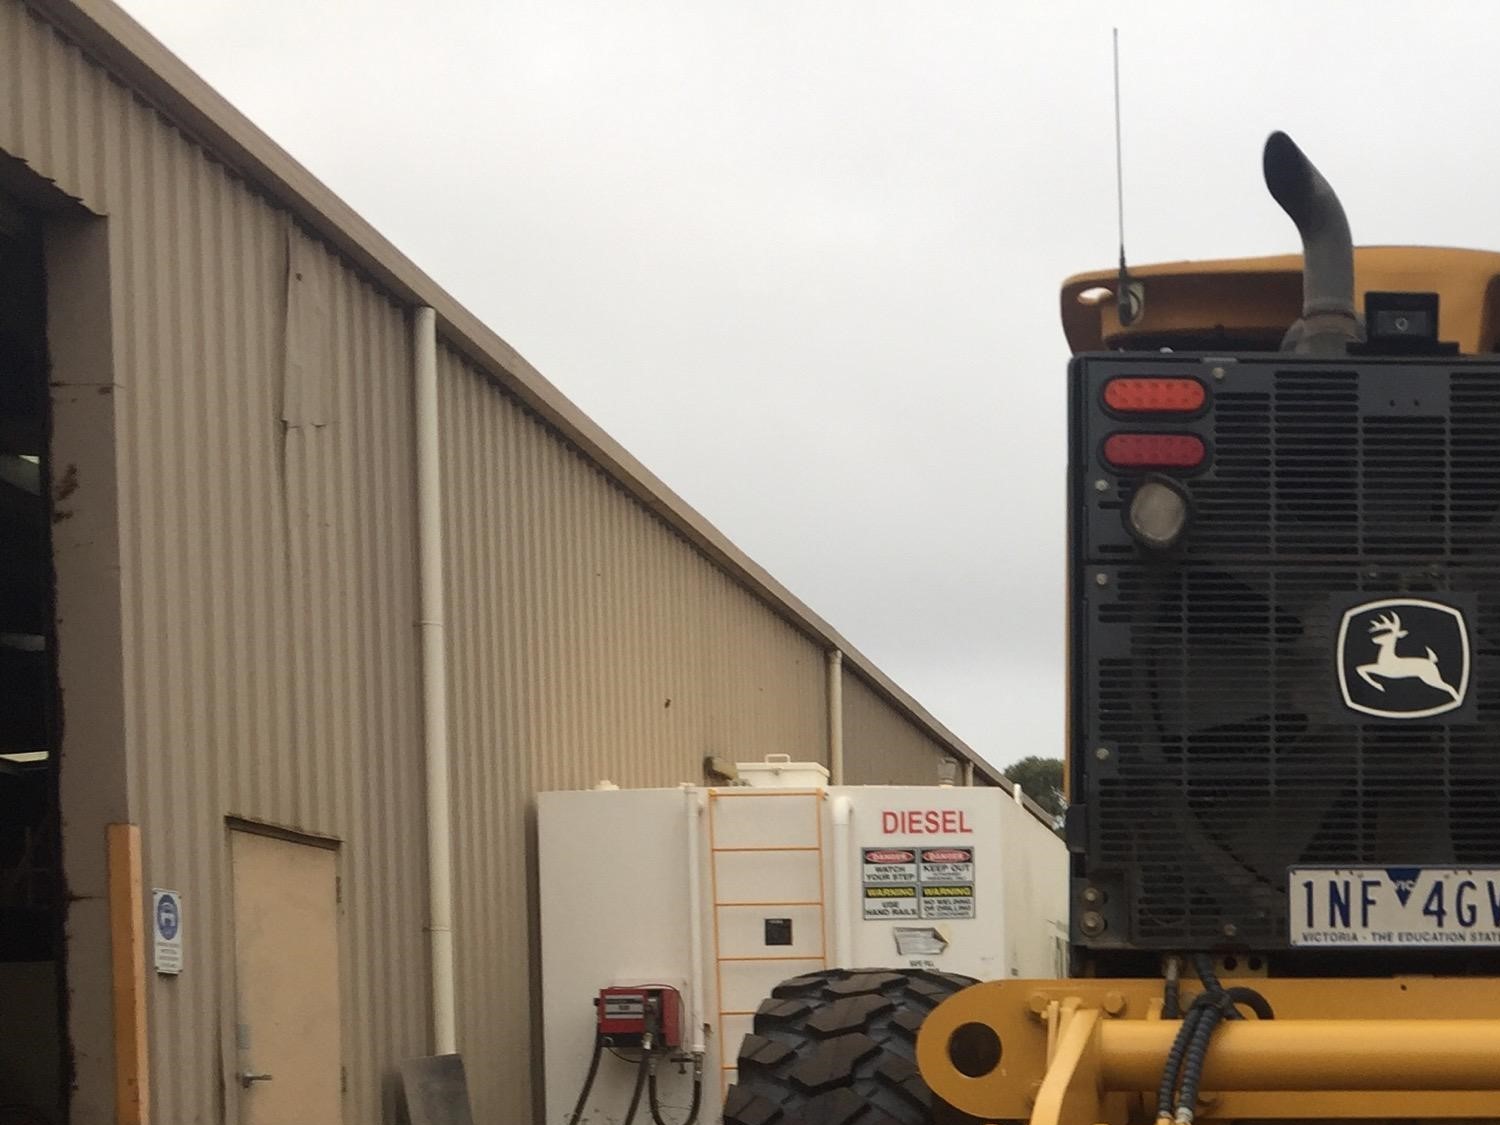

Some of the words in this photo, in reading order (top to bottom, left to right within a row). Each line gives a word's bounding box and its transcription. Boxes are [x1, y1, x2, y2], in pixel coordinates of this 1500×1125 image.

[882, 811, 973, 834] DIESEL
[923, 864, 949, 872] KEEP
[951, 864, 970, 872] OUT
[866, 873, 891, 881] YOUR
[892, 873, 915, 881] STEP
[867, 888, 914, 896] WARNING
[924, 887, 971, 895] WARNING
[1302, 880, 1382, 928] 1NF
[1302, 932, 1359, 942] VICTORIA
[1371, 932, 1393, 942] THE
[1400, 932, 1466, 942] EDUCATION
